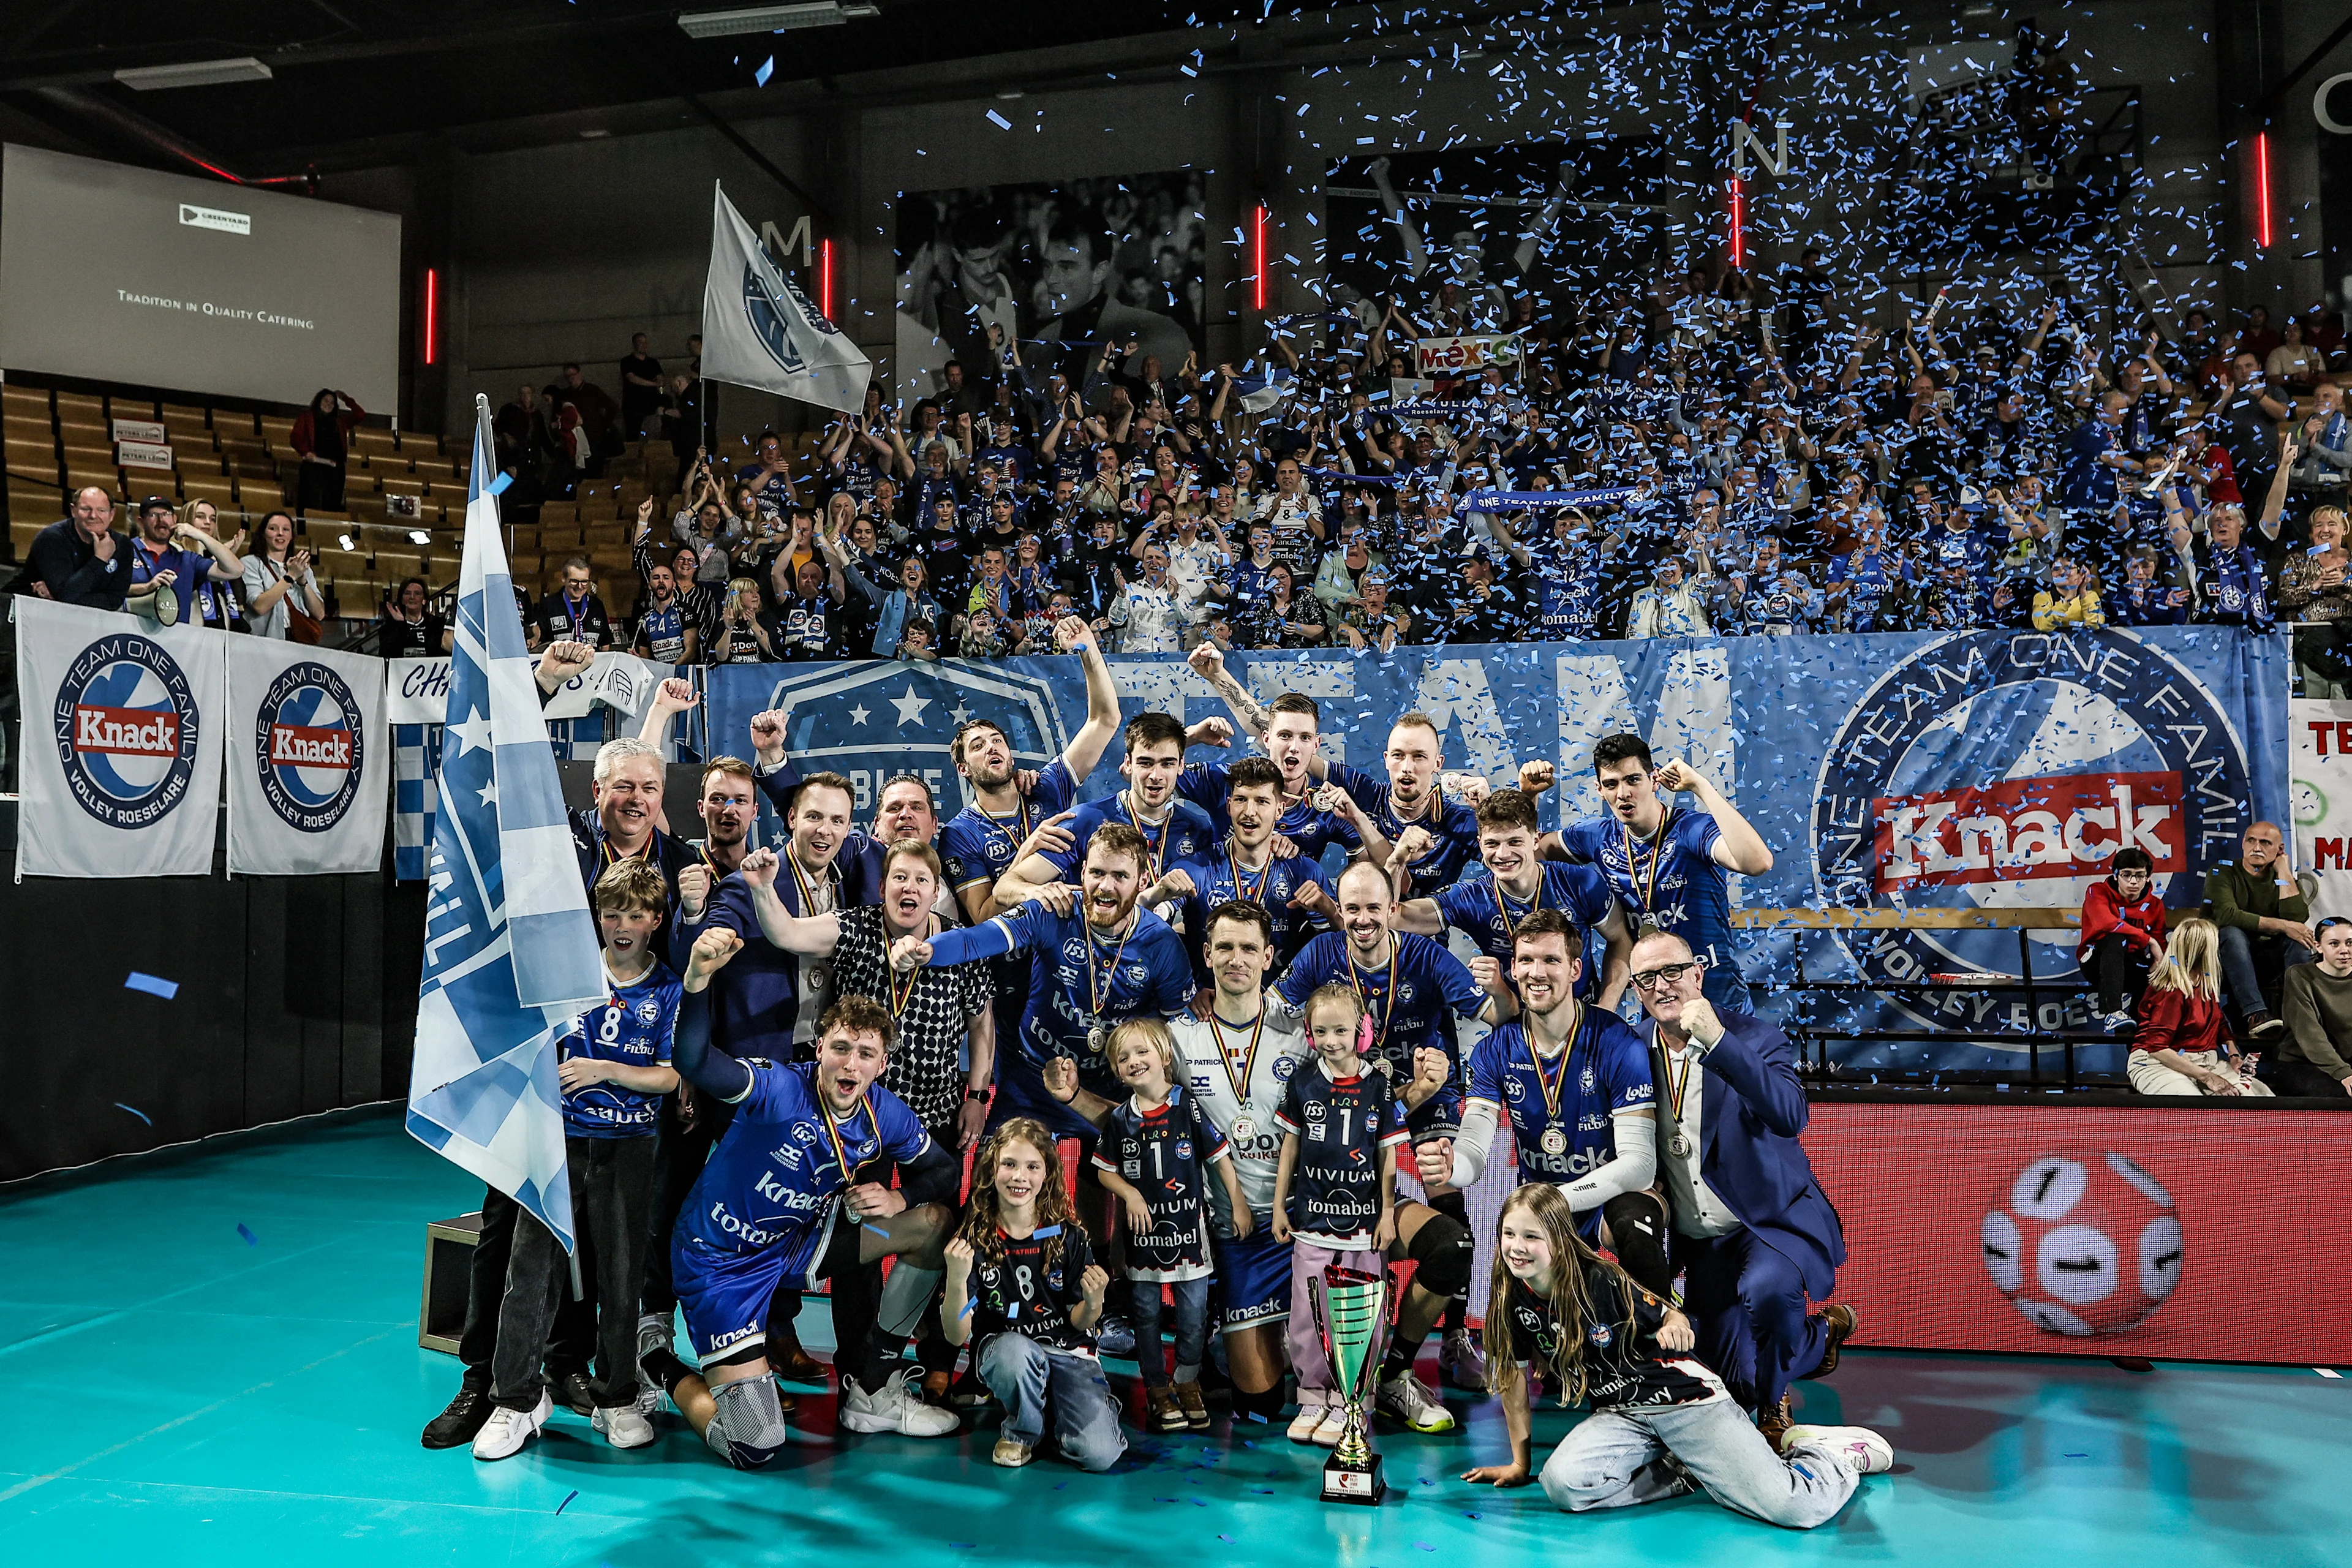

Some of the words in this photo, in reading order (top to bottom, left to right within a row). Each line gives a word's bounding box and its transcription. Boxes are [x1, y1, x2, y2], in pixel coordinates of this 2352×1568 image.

[1733, 116, 1787, 178] N
[762, 216, 812, 266] M
[1477, 497, 1499, 508] ONE
[1575, 491, 1624, 504] FAMILY
[1283, 509, 1291, 520] 8
[1256, 575, 1264, 590] 4
[658, 617, 666, 633] 4
[1544, 610, 1598, 625] tomabel
[417, 632, 424, 643] 5
[652, 640, 673, 650] Knack
[1051, 639, 1061, 655] 5
[57, 699, 74, 763] ONE
[66, 639, 121, 690] TEAM
[127, 640, 171, 676] ONE
[169, 677, 198, 771] FAMILY
[77, 709, 175, 752] Knack
[257, 718, 270, 774] ONE
[264, 667, 307, 709] TEAM
[311, 667, 344, 699] ONE
[343, 696, 363, 783] FAMILY
[272, 728, 350, 766] Knack
[1847, 645, 1984, 769] TEAM
[2010, 634, 2140, 688] ONE
[2144, 684, 2237, 877] FAMIL
[70, 768, 114, 820] VOLLEY
[117, 775, 187, 824] ROESELARE
[266, 779, 301, 824] VOLLEY
[303, 783, 353, 828] ROESELARE
[1883, 783, 2173, 880] Knack
[1660, 878, 1687, 892] FILOU
[1627, 903, 1689, 929] nack
[600, 1006, 621, 1042] 8
[623, 1043, 655, 1055] FILOU
[1434, 1104, 1446, 1118] 4
[1340, 1109, 1352, 1145] 1
[1578, 1118, 1608, 1132] FILOU
[1150, 1142, 1163, 1180] 1
[1305, 1166, 1376, 1183] VIVIUM
[1147, 1197, 1198, 1215] VIUM
[1308, 1198, 1376, 1216] tomabel
[1134, 1228, 1197, 1248] tomabel
[1016, 1265, 1034, 1302] 8
[1226, 1297, 1282, 1322] knack
